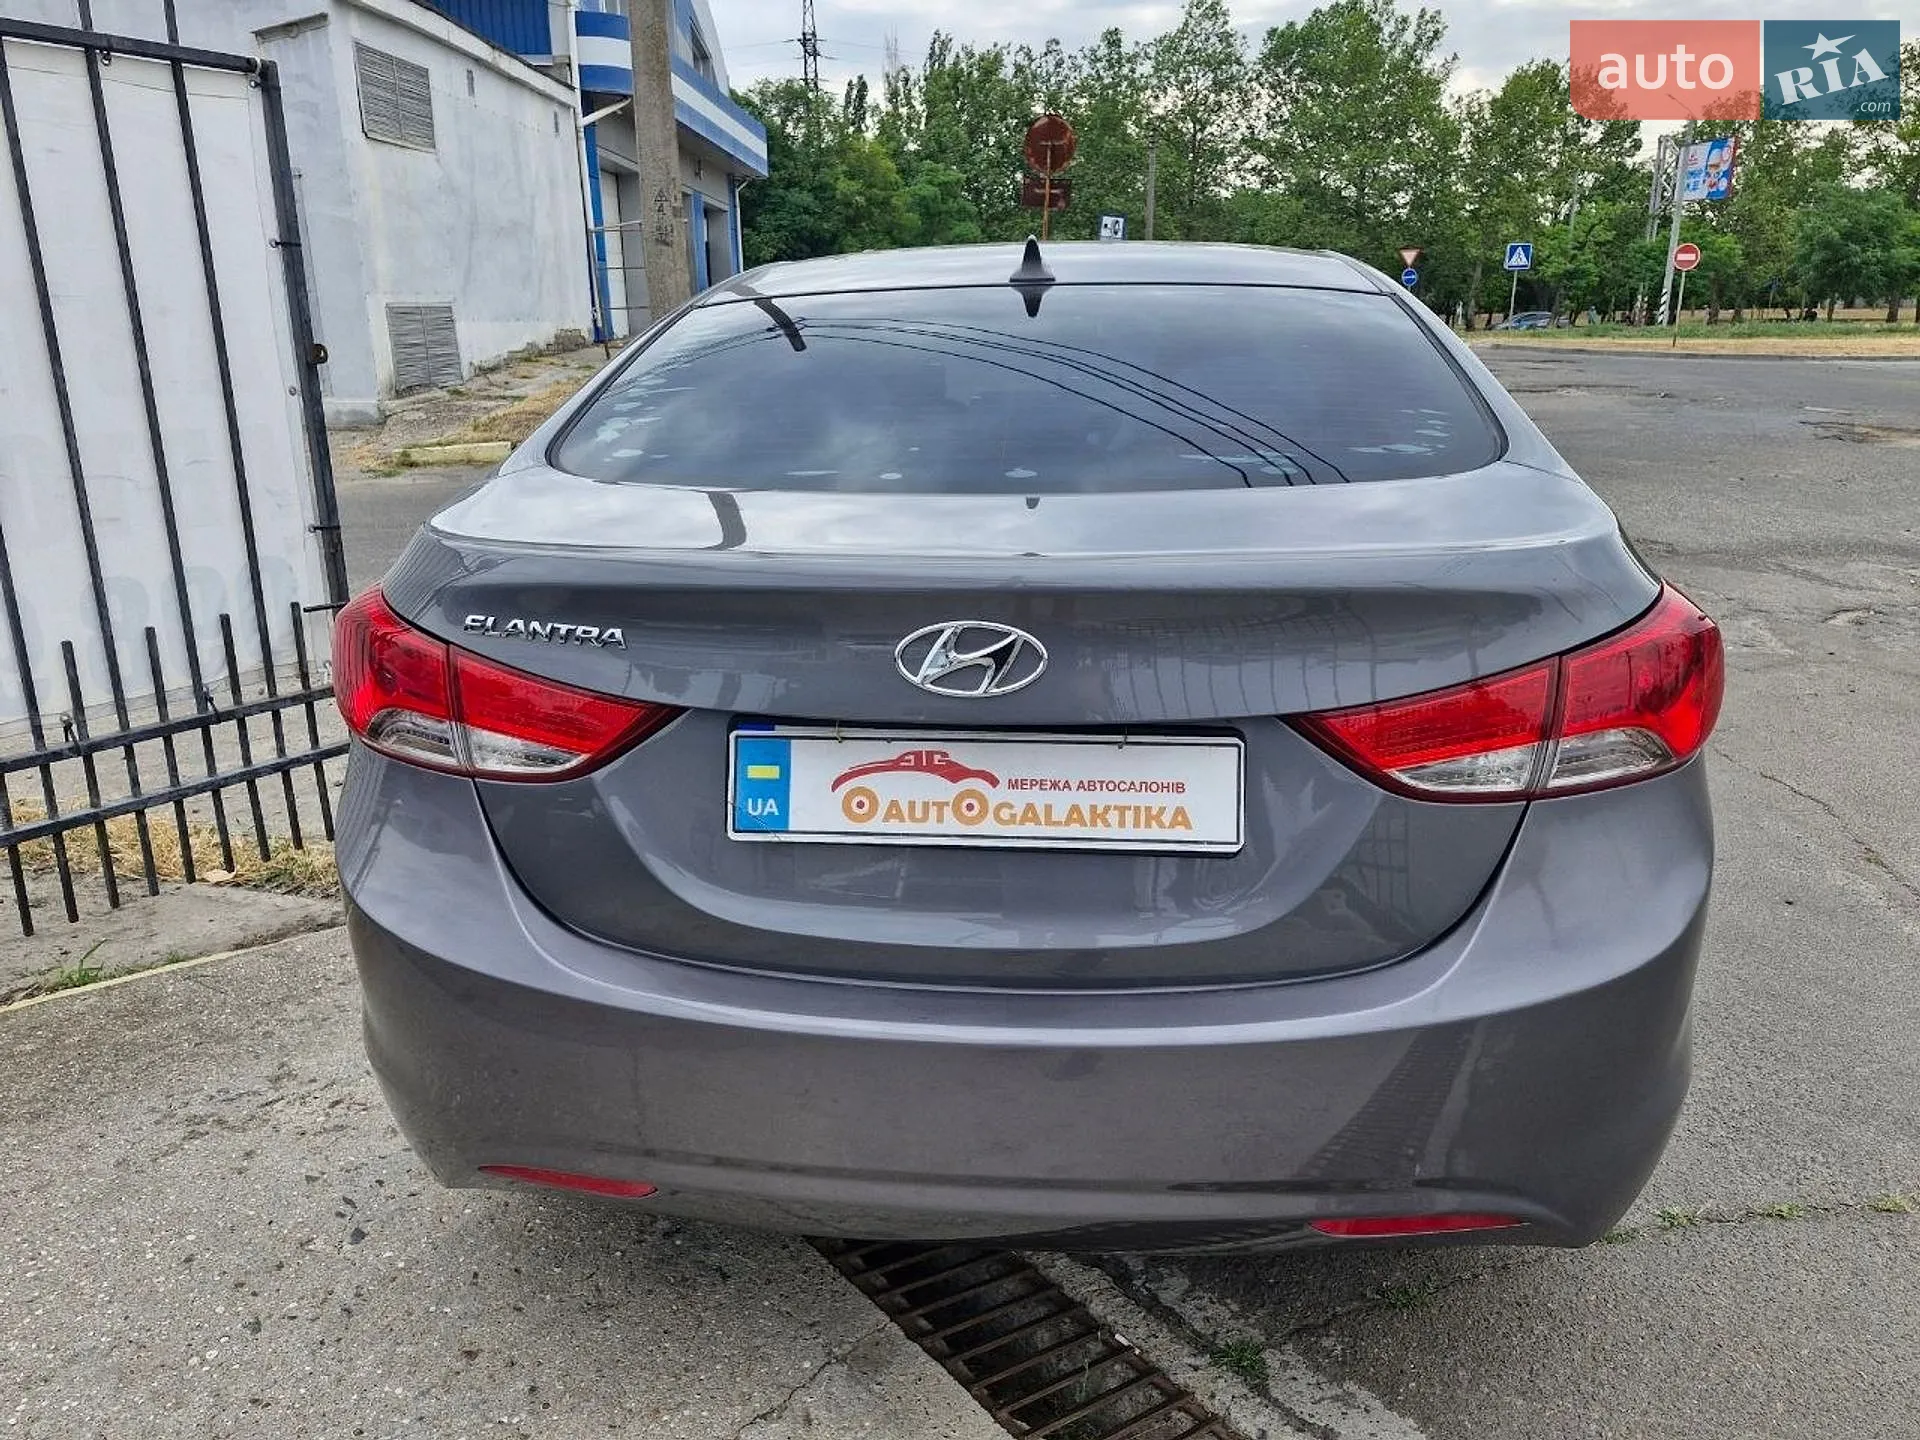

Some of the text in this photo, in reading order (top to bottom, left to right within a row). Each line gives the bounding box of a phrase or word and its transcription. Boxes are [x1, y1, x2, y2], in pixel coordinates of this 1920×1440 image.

[464, 614, 628, 650] ELANTRA
[1007, 778, 1186, 795] МЕРЕЖА АВТОСАЛОНІВ
[747, 797, 780, 816] UA
